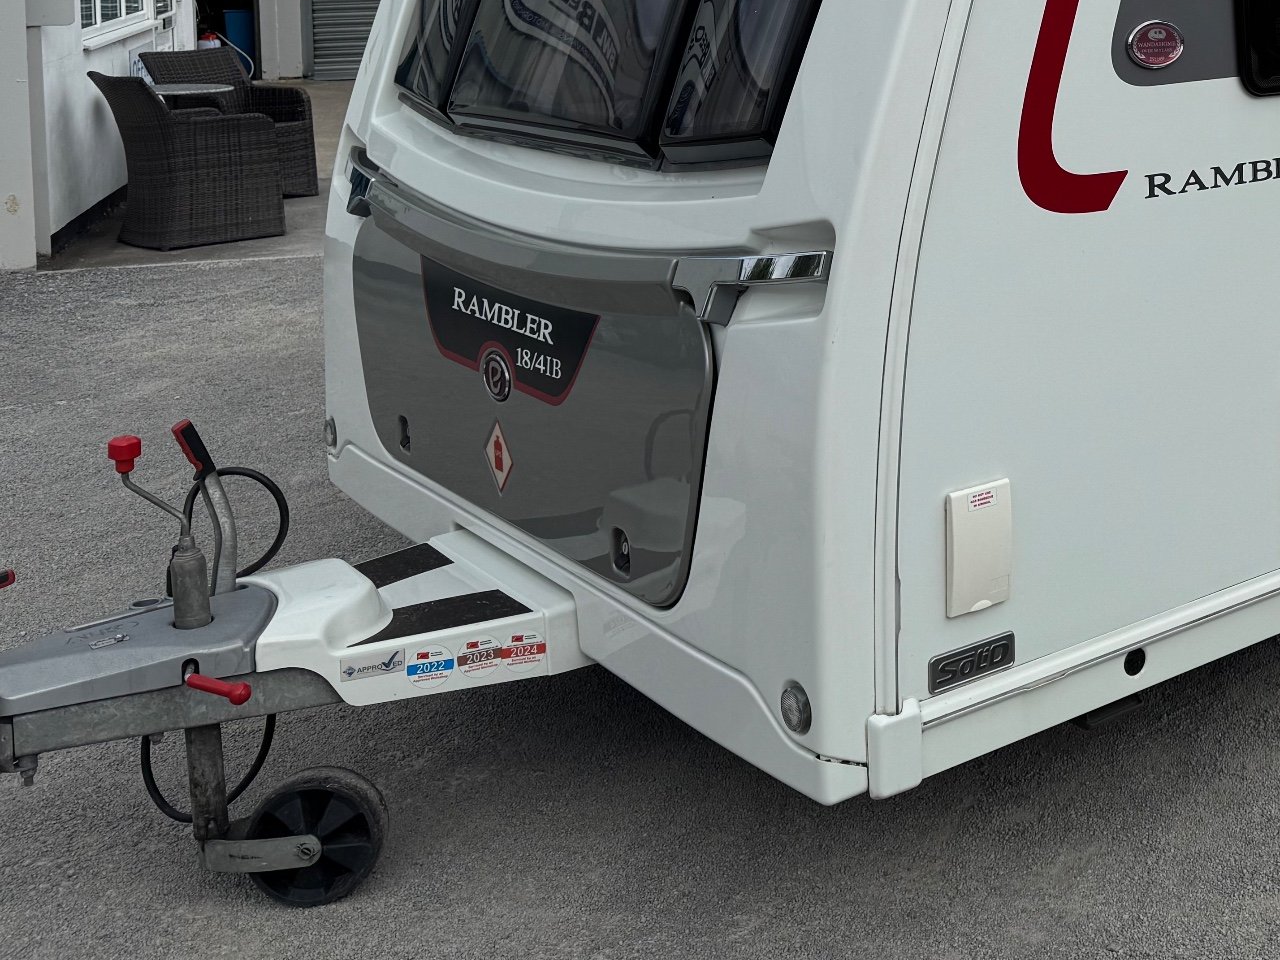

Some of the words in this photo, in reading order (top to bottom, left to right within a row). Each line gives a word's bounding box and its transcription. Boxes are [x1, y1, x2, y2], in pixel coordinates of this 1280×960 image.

[452, 286, 554, 346] RAMBLER
[515, 347, 562, 380] 18/4IB
[466, 650, 494, 664] 2023
[510, 645, 538, 657] 2024
[416, 660, 445, 674] 2022
